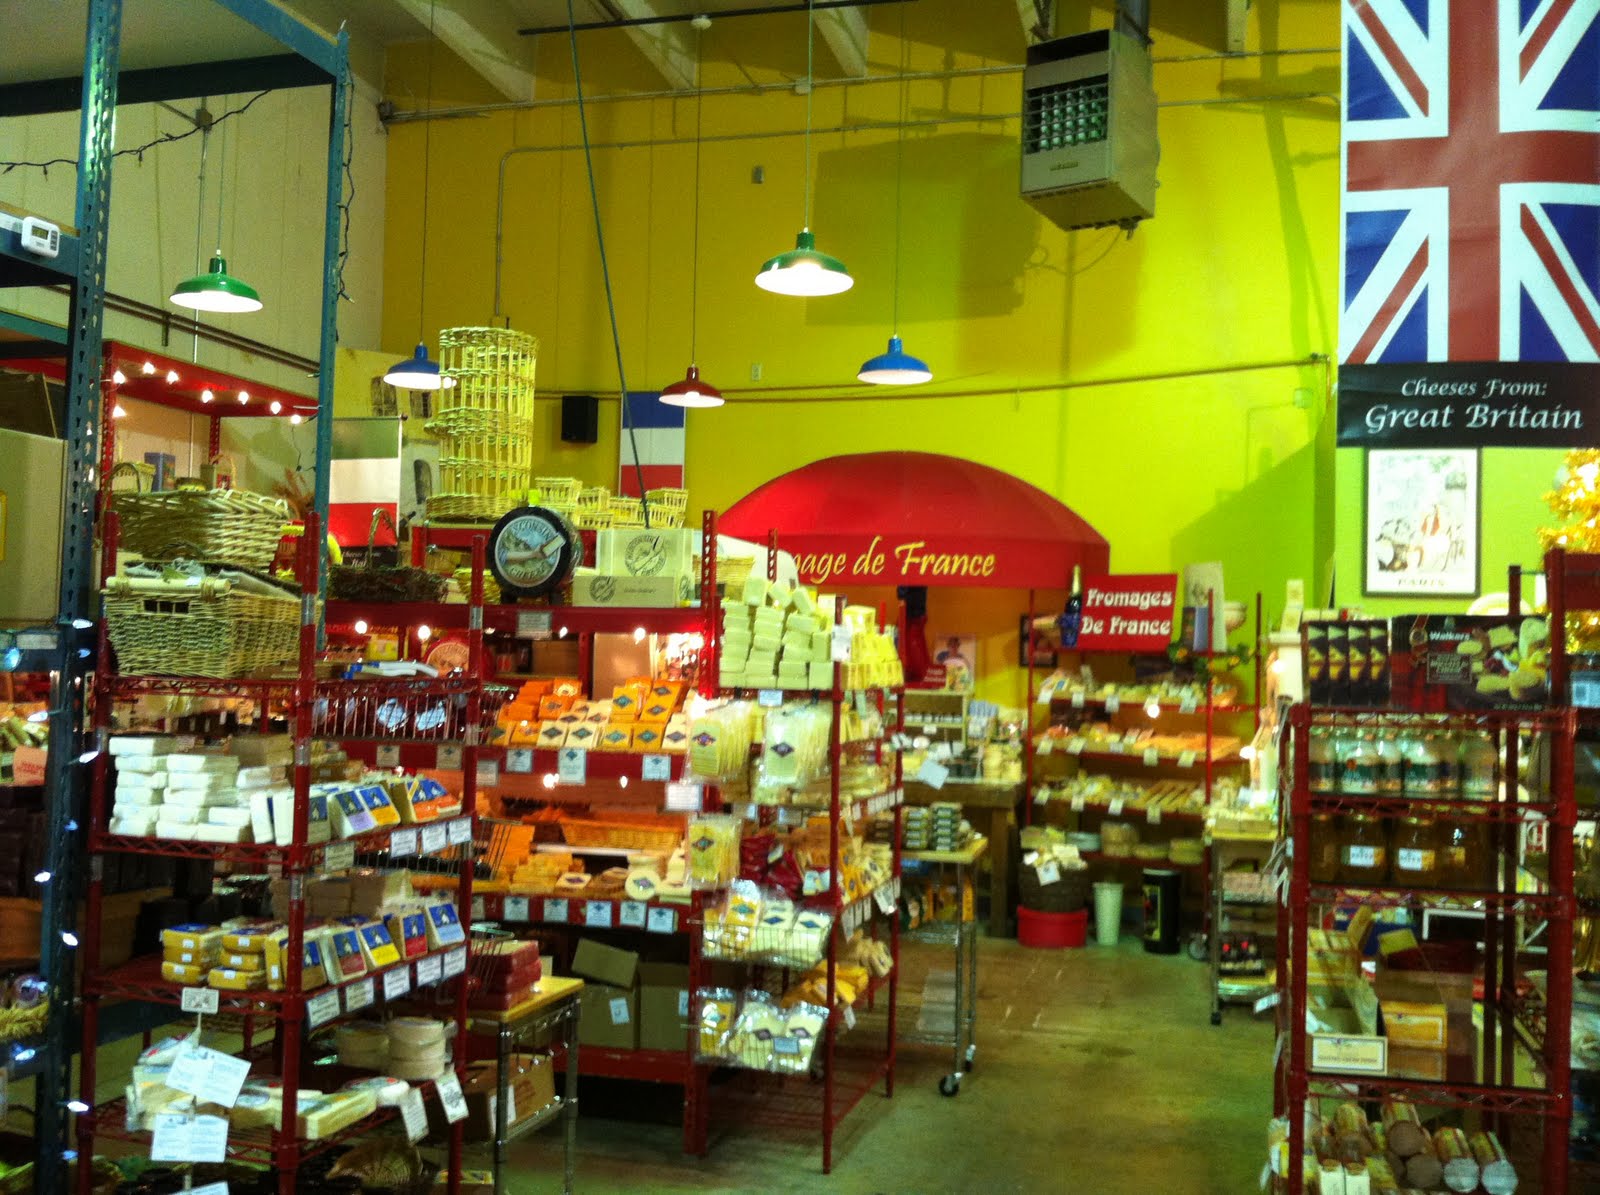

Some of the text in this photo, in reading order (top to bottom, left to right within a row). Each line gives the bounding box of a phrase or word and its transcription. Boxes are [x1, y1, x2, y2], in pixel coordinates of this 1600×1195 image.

[1401, 376, 1548, 399] Cheeses From:
[1365, 402, 1584, 434] Great Britain
[852, 535, 886, 576] de
[894, 541, 996, 577] France
[1085, 588, 1173, 611] Fromages
[1080, 615, 1171, 636] De France
